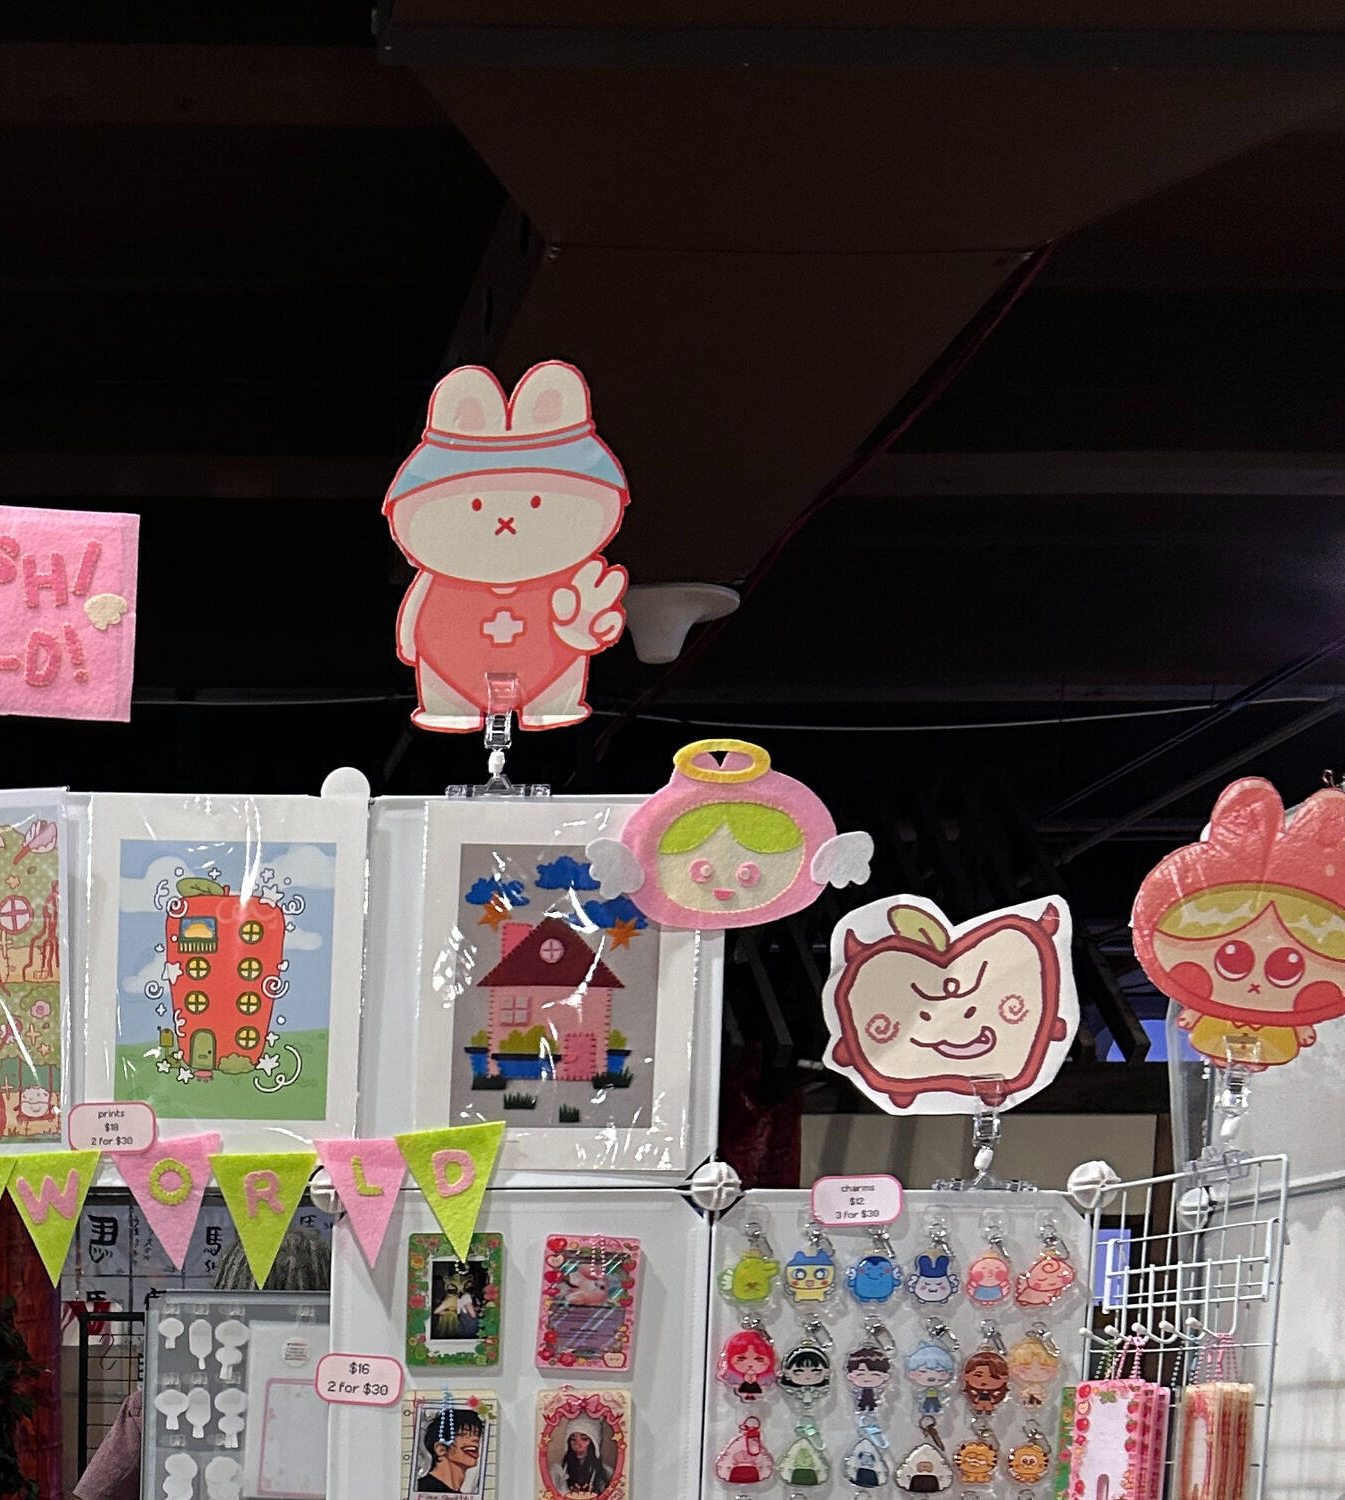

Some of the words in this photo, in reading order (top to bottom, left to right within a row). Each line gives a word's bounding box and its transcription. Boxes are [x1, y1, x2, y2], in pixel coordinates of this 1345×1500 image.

[98, 1109, 125, 1119] prints
[91, 1137, 97, 1145] 2
[98, 1137, 113, 1145] for
[115, 1136, 133, 1146] $30
[841, 1185, 875, 1193] charms
[835, 1211, 842, 1219] 3
[843, 1211, 859, 1219] for
[861, 1209, 880, 1219] $30
[349, 1361, 370, 1375] $16
[327, 1380, 336, 1393] 2
[338, 1381, 360, 1393] for
[363, 1382, 389, 1396] $30
